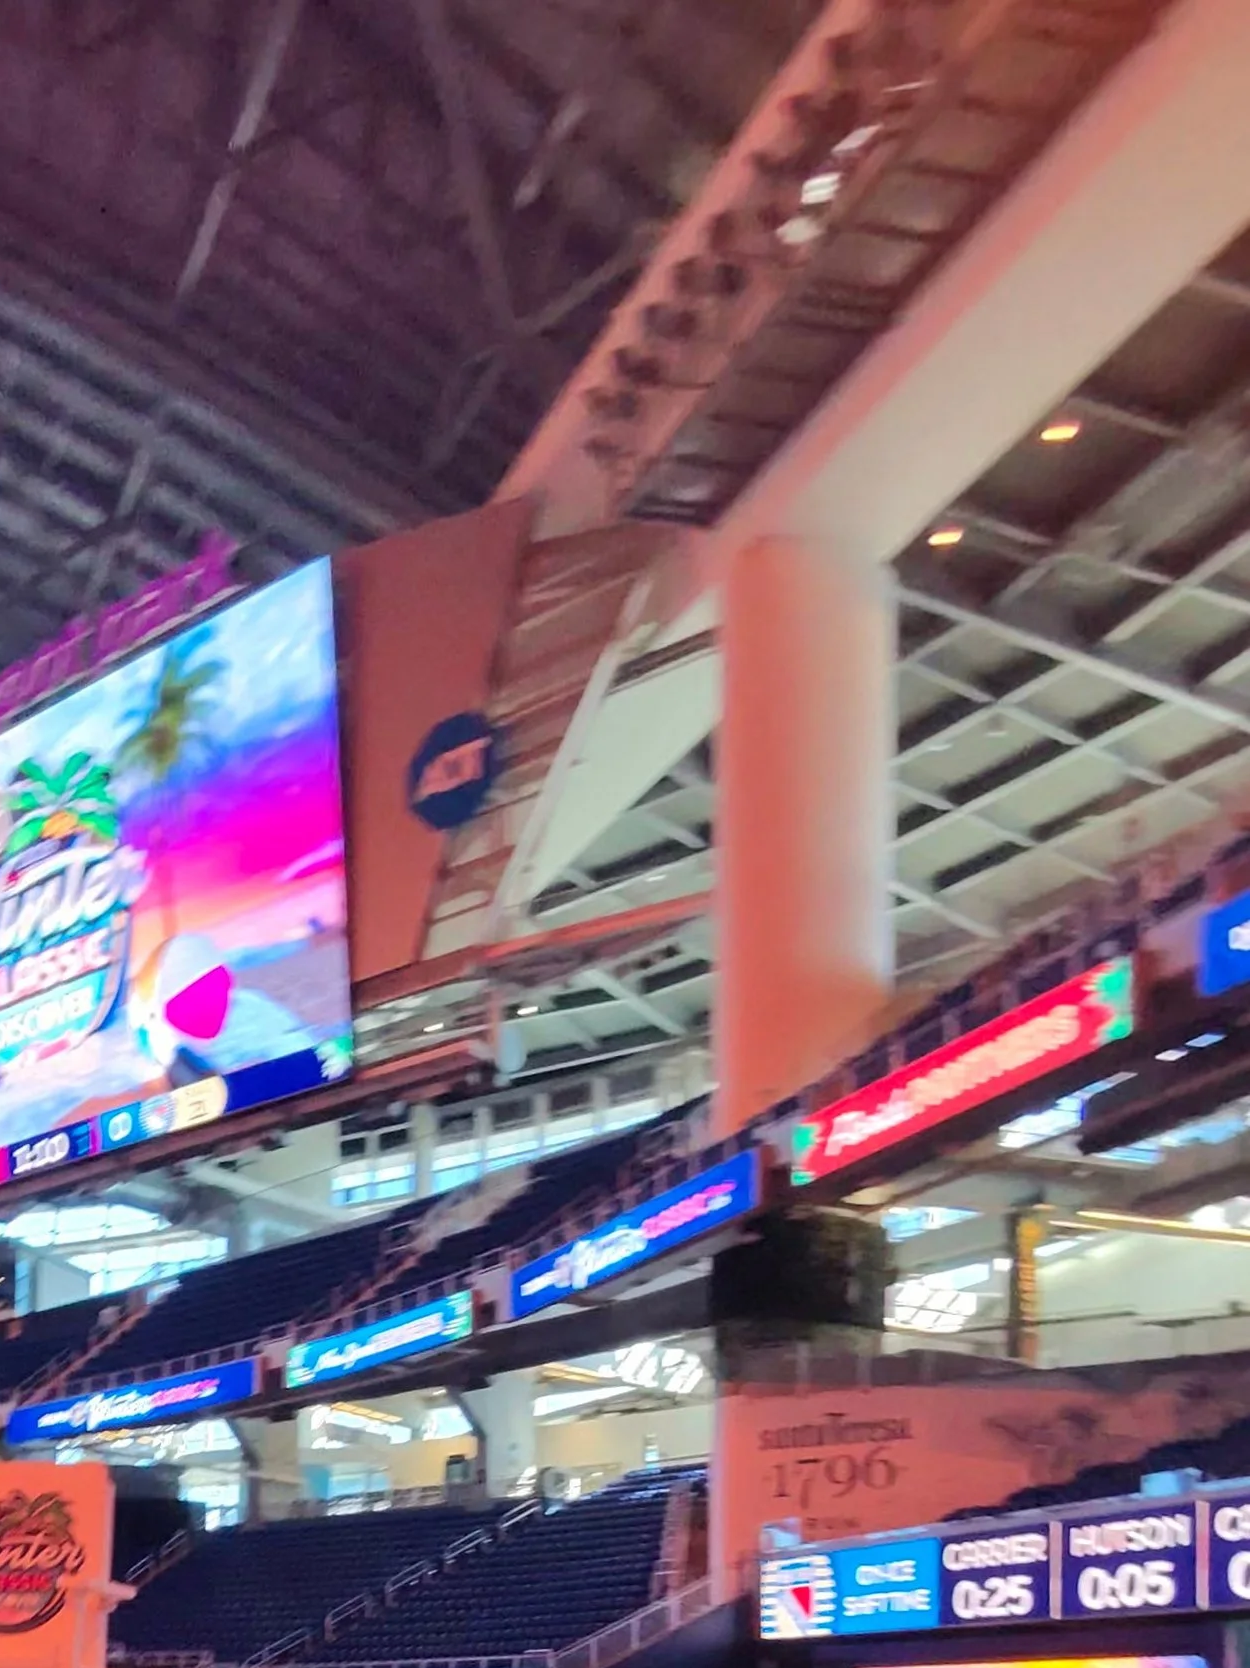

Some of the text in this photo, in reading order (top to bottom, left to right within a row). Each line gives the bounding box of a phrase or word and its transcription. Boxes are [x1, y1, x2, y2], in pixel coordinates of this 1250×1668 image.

[770, 1446, 899, 1510] 1796
[952, 1575, 1035, 1620] 0:25
[1077, 1560, 1176, 1610] 0:05
